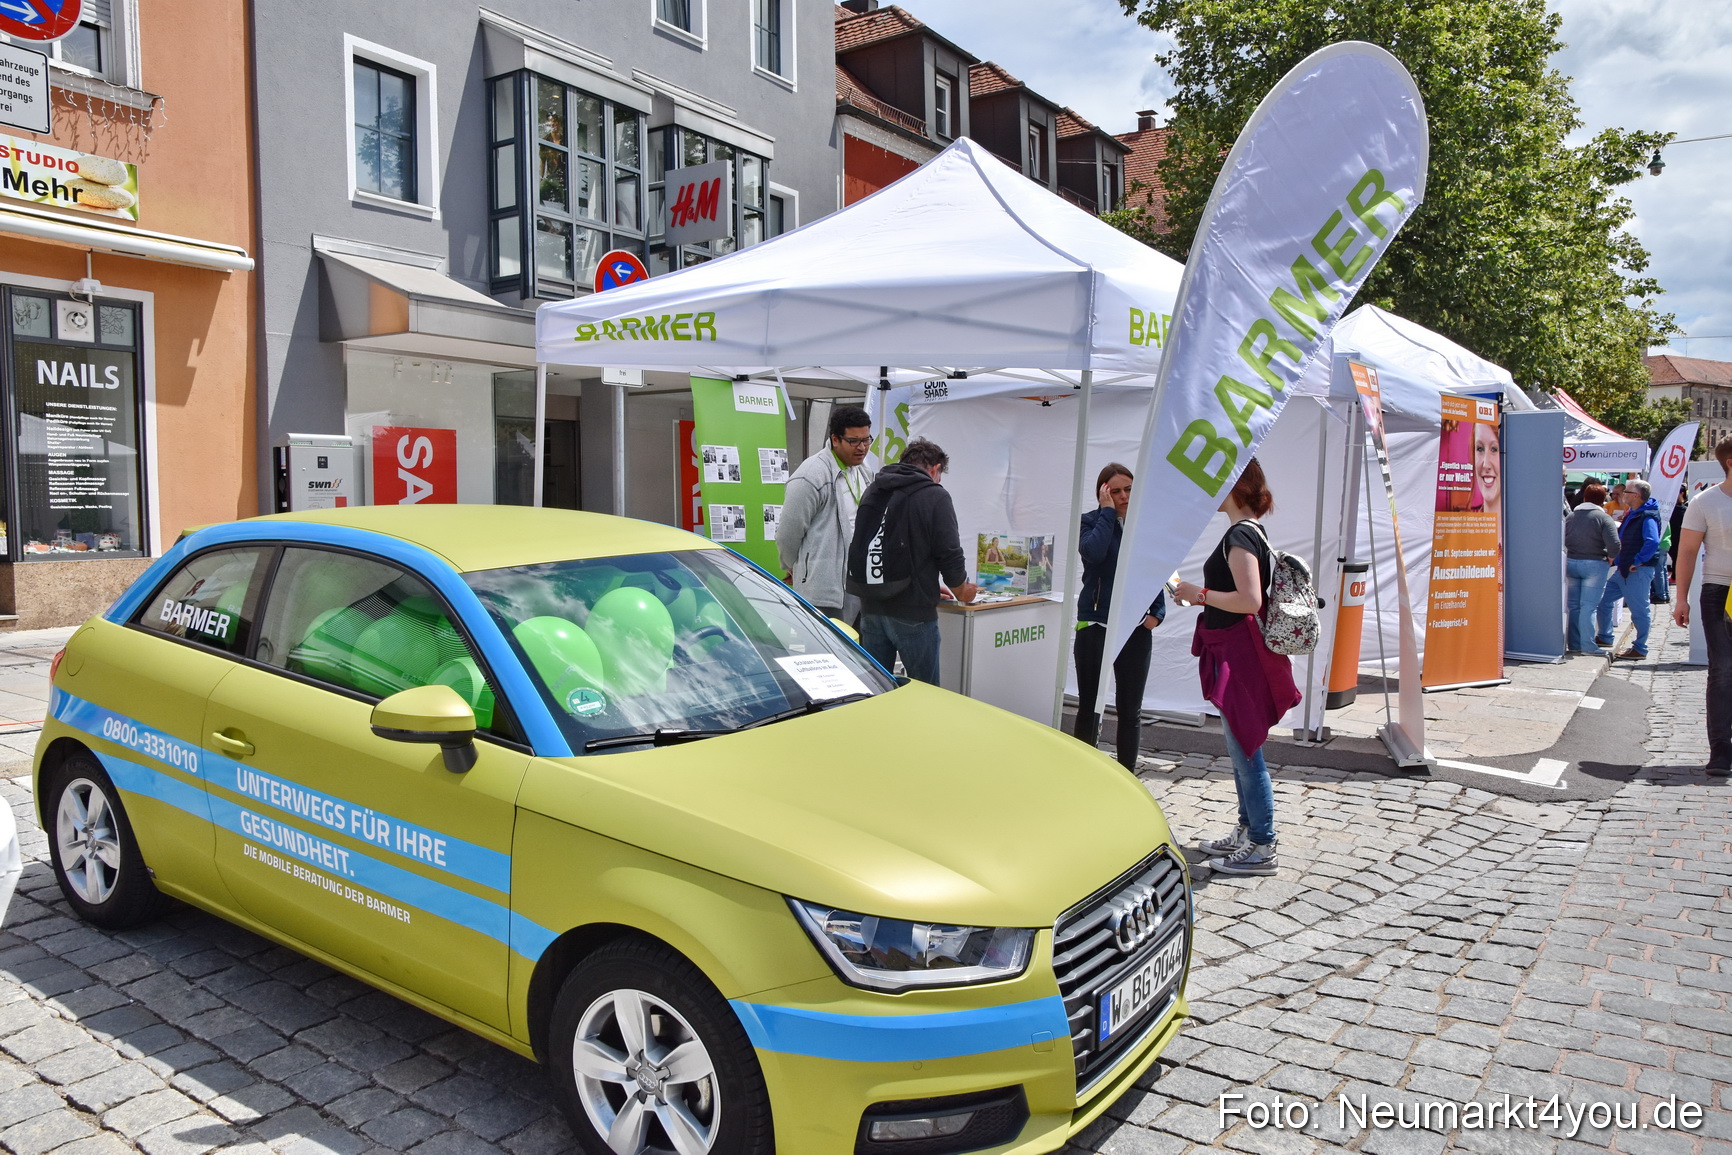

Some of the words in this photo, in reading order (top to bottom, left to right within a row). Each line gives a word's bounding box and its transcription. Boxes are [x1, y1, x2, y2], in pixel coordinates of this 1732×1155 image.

[15, 77, 30, 88] des
[0, 144, 80, 174] STUDIO
[2, 167, 83, 204] Mehr
[671, 177, 721, 228] H&M
[574, 312, 717, 341] BARMER
[1166, 168, 1406, 499] BARMER
[37, 359, 120, 390] NAILS
[739, 395, 775, 407] BARMER
[924, 388, 948, 399] SHADE
[1479, 406, 1493, 416] OBI
[1579, 450, 1638, 460] bfwnürnberg
[308, 481, 332, 489] swn
[1432, 564, 1495, 580] Auszubildende
[160, 599, 231, 639] BARMER
[994, 625, 1045, 648] BARMER
[103, 716, 198, 773] 0800-3331010
[236, 767, 345, 829] UNTERWEGS
[351, 808, 390, 847] FÜR
[396, 825, 447, 867] IHRE
[240, 810, 355, 877] GESUNDHEIT.
[243, 843, 258, 859] DIE
[259, 846, 292, 874] MOBILE
[293, 865, 343, 896] BERATUNG
[344, 886, 365, 906] DER
[366, 895, 411, 924] BARMER
[1111, 988, 1123, 1027] W
[1132, 965, 1151, 1010] BG
[1154, 934, 1182, 990] 9044
[1102, 1021, 1107, 1031] D
